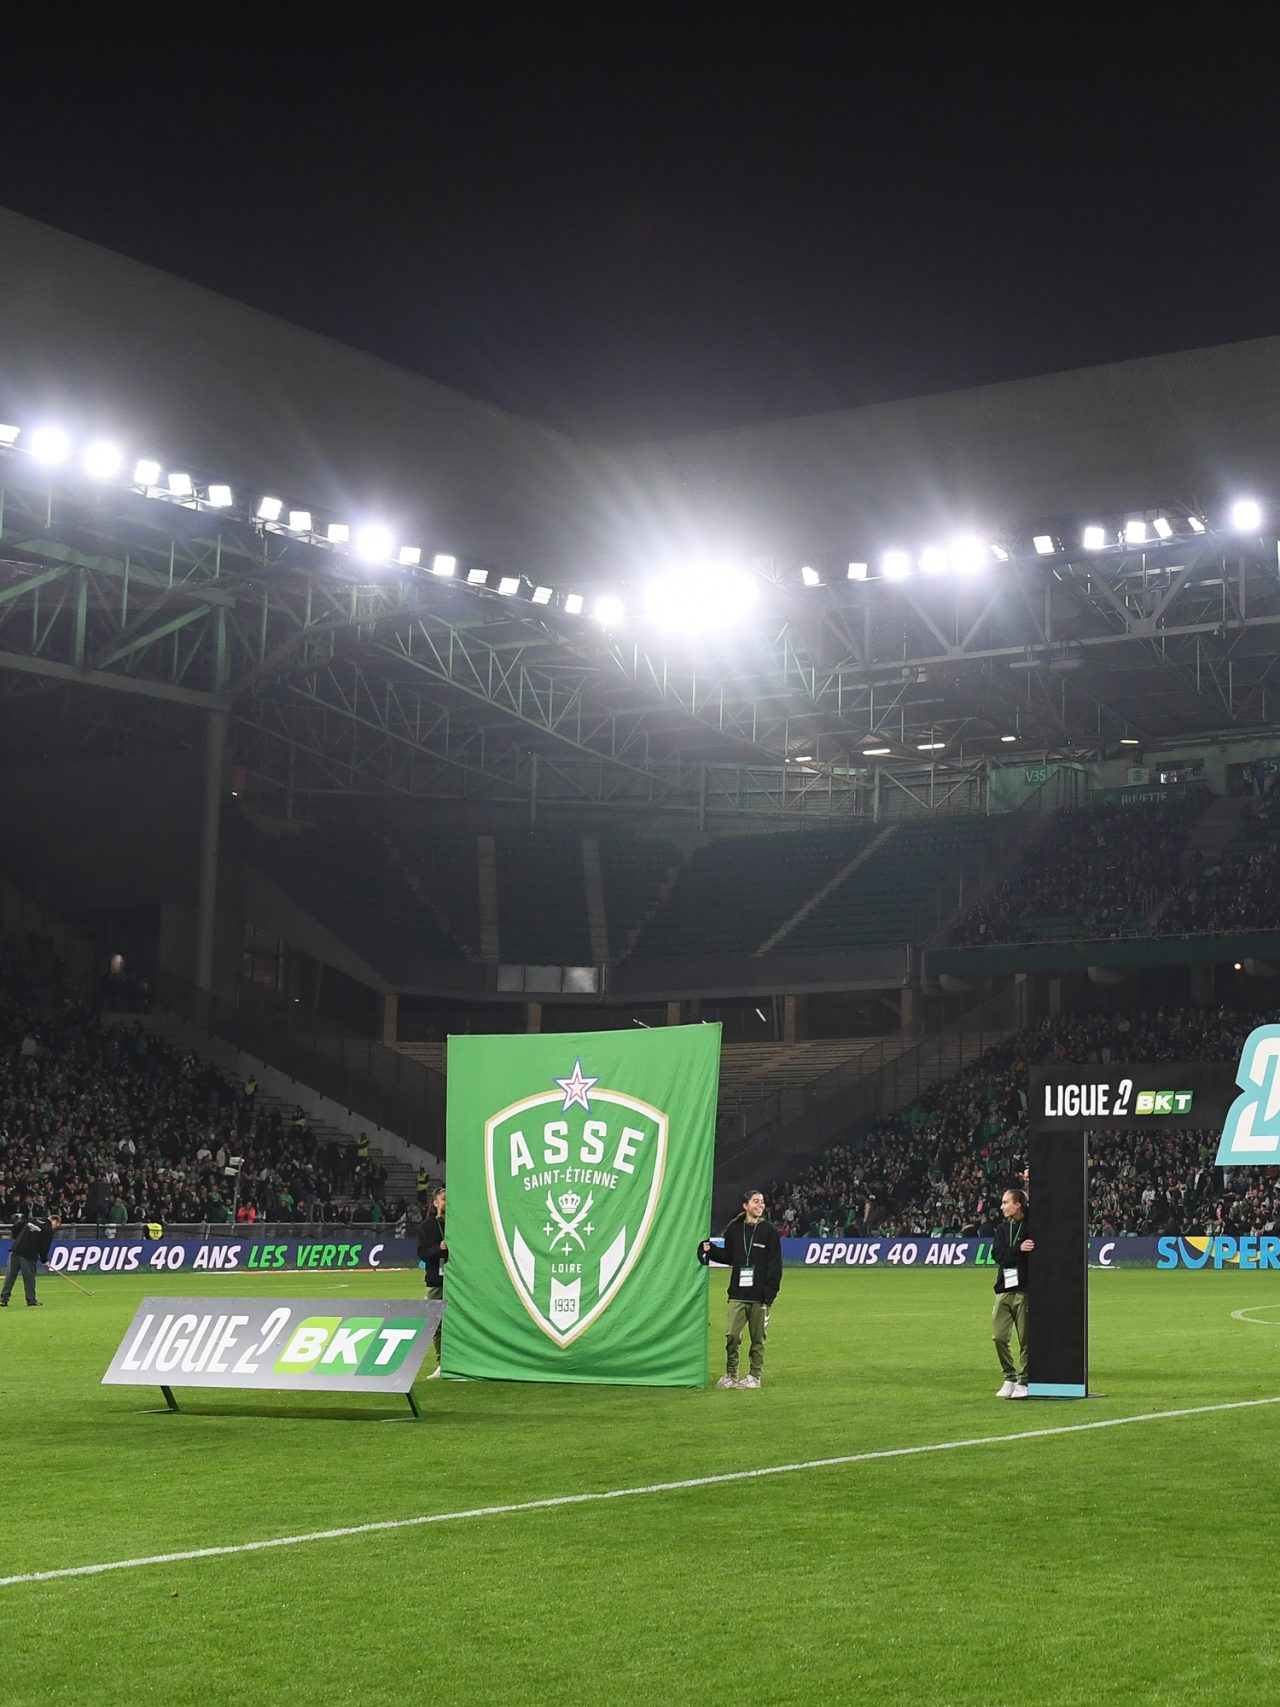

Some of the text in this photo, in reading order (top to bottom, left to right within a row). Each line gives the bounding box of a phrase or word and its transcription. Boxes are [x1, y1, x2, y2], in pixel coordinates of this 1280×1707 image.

[1025, 769, 1046, 782] V35
[1044, 1079, 1193, 1117] LIGUE 2 BKT
[510, 1120, 645, 1177] ASSE
[523, 1166, 619, 1191] SAINT-ÉTIENNE
[49, 1243, 384, 1272] DEPUIS 40 ANS LES VERTS C
[805, 1243, 879, 1265] DEPUIS
[887, 1243, 918, 1265] 40
[925, 1243, 968, 1265] ANS
[551, 1263, 582, 1274] LOIRE
[554, 1297, 576, 1313] 1933
[120, 1306, 417, 1374] LIGUE 2 BKT
